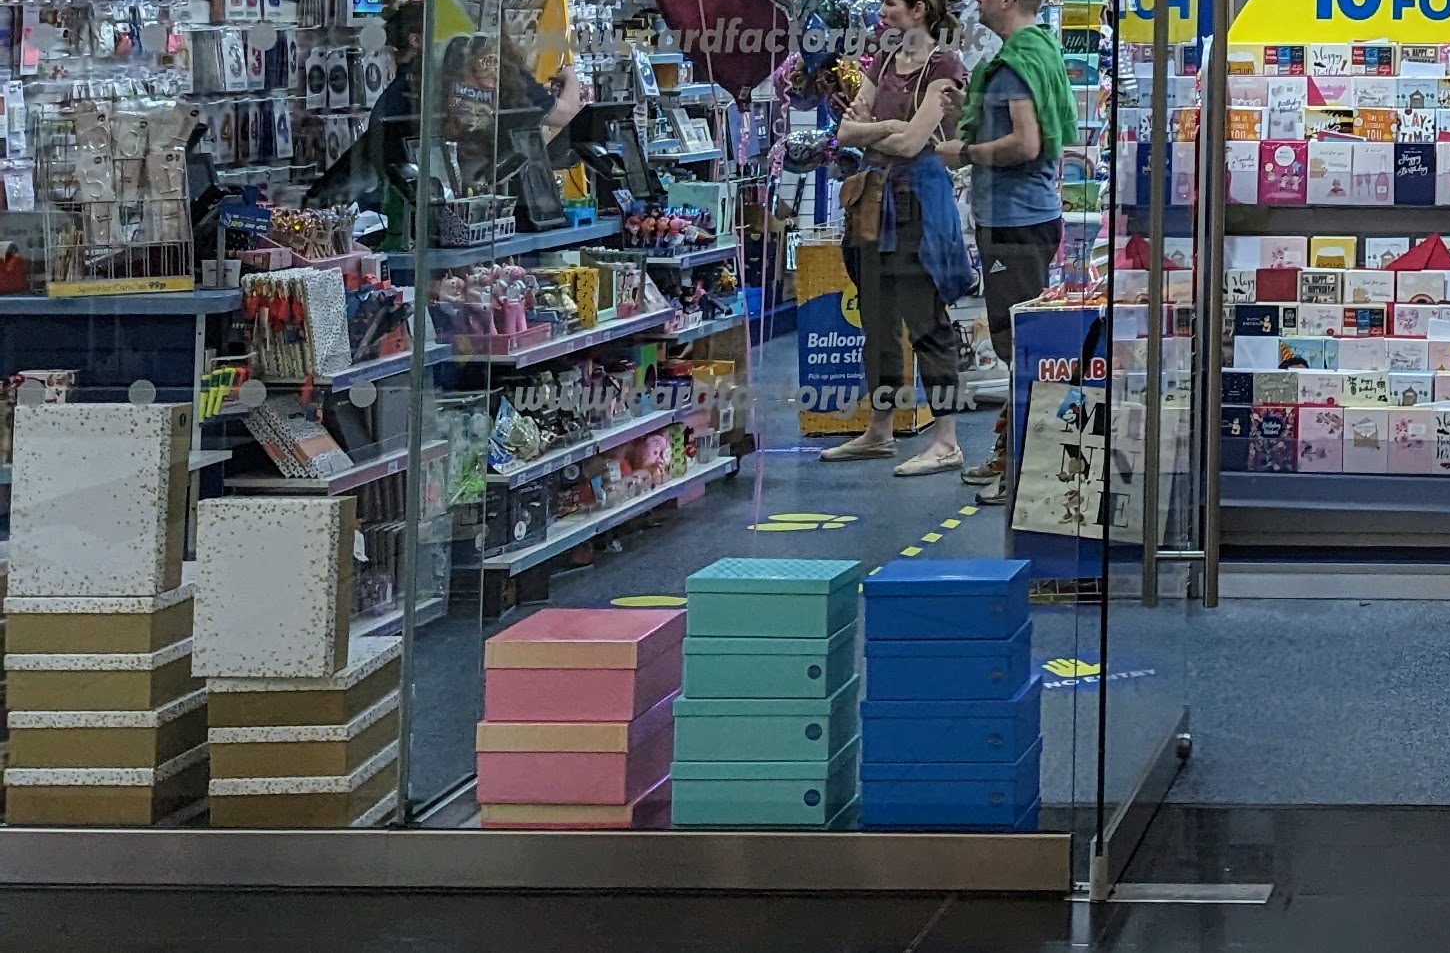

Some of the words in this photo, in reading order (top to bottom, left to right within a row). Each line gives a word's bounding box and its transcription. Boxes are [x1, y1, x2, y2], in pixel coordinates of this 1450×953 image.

[808, 351, 828, 364] on
[830, 352, 840, 364] a
[843, 347, 862, 364] sti
[1043, 679, 1080, 688] NO
